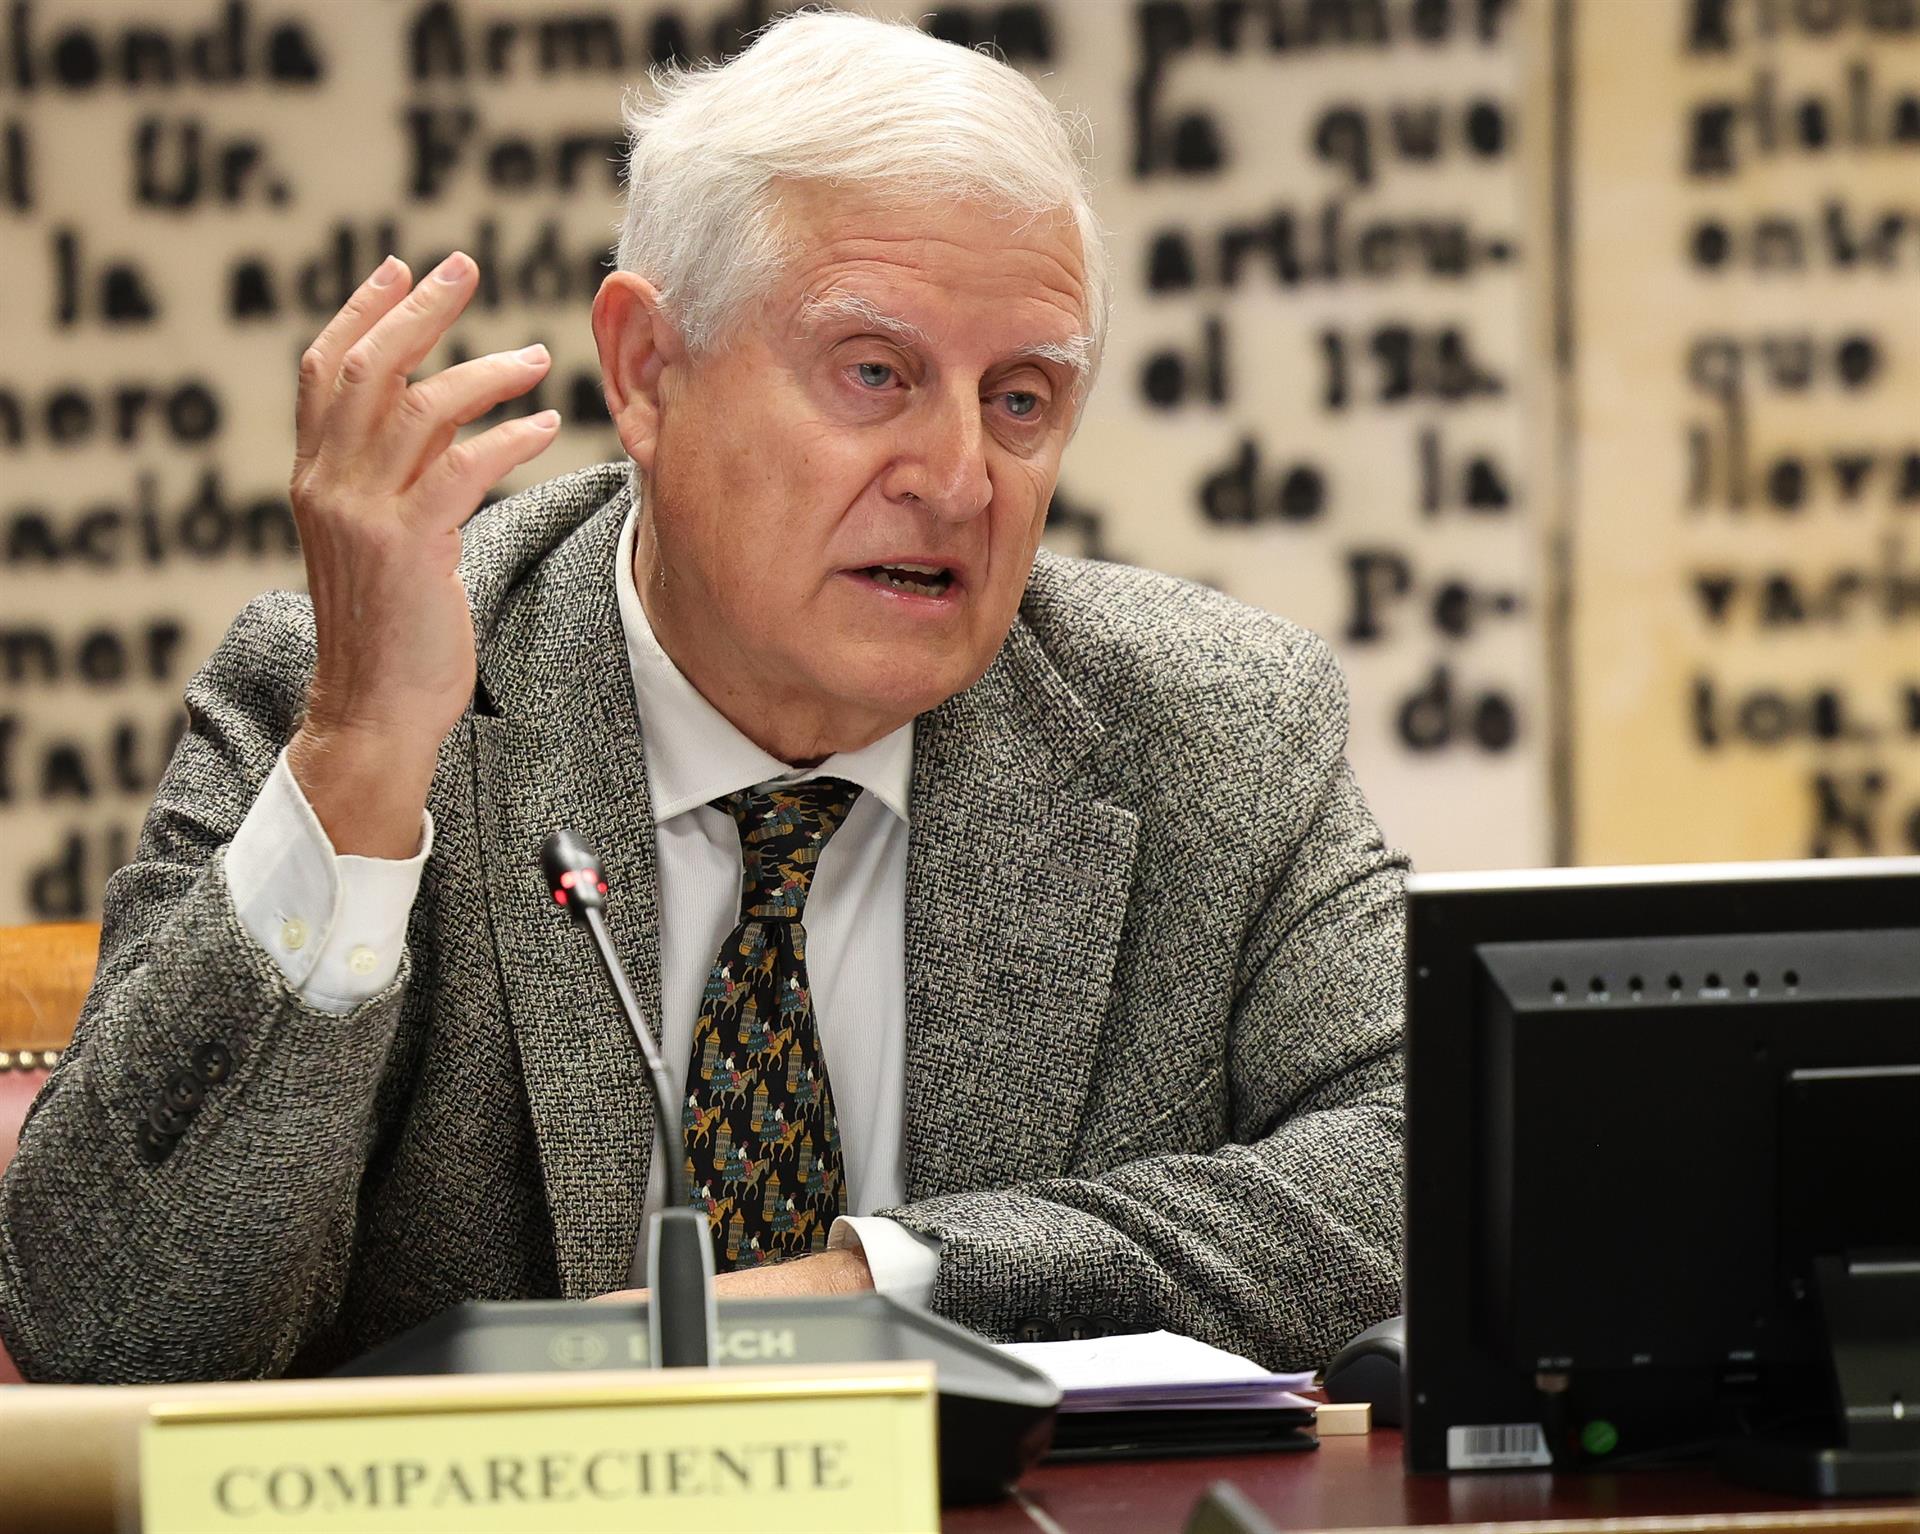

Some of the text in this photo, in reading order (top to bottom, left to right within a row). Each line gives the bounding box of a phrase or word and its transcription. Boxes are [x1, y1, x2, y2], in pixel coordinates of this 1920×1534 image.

[1310, 98, 1512, 190] que
[52, 226, 160, 328] la
[1200, 432, 1328, 526] de
[1416, 424, 1512, 518] la
[1394, 662, 1520, 758] de
[626, 1329, 797, 1362] BCH
[212, 1440, 854, 1520] COMPARECIENTE
